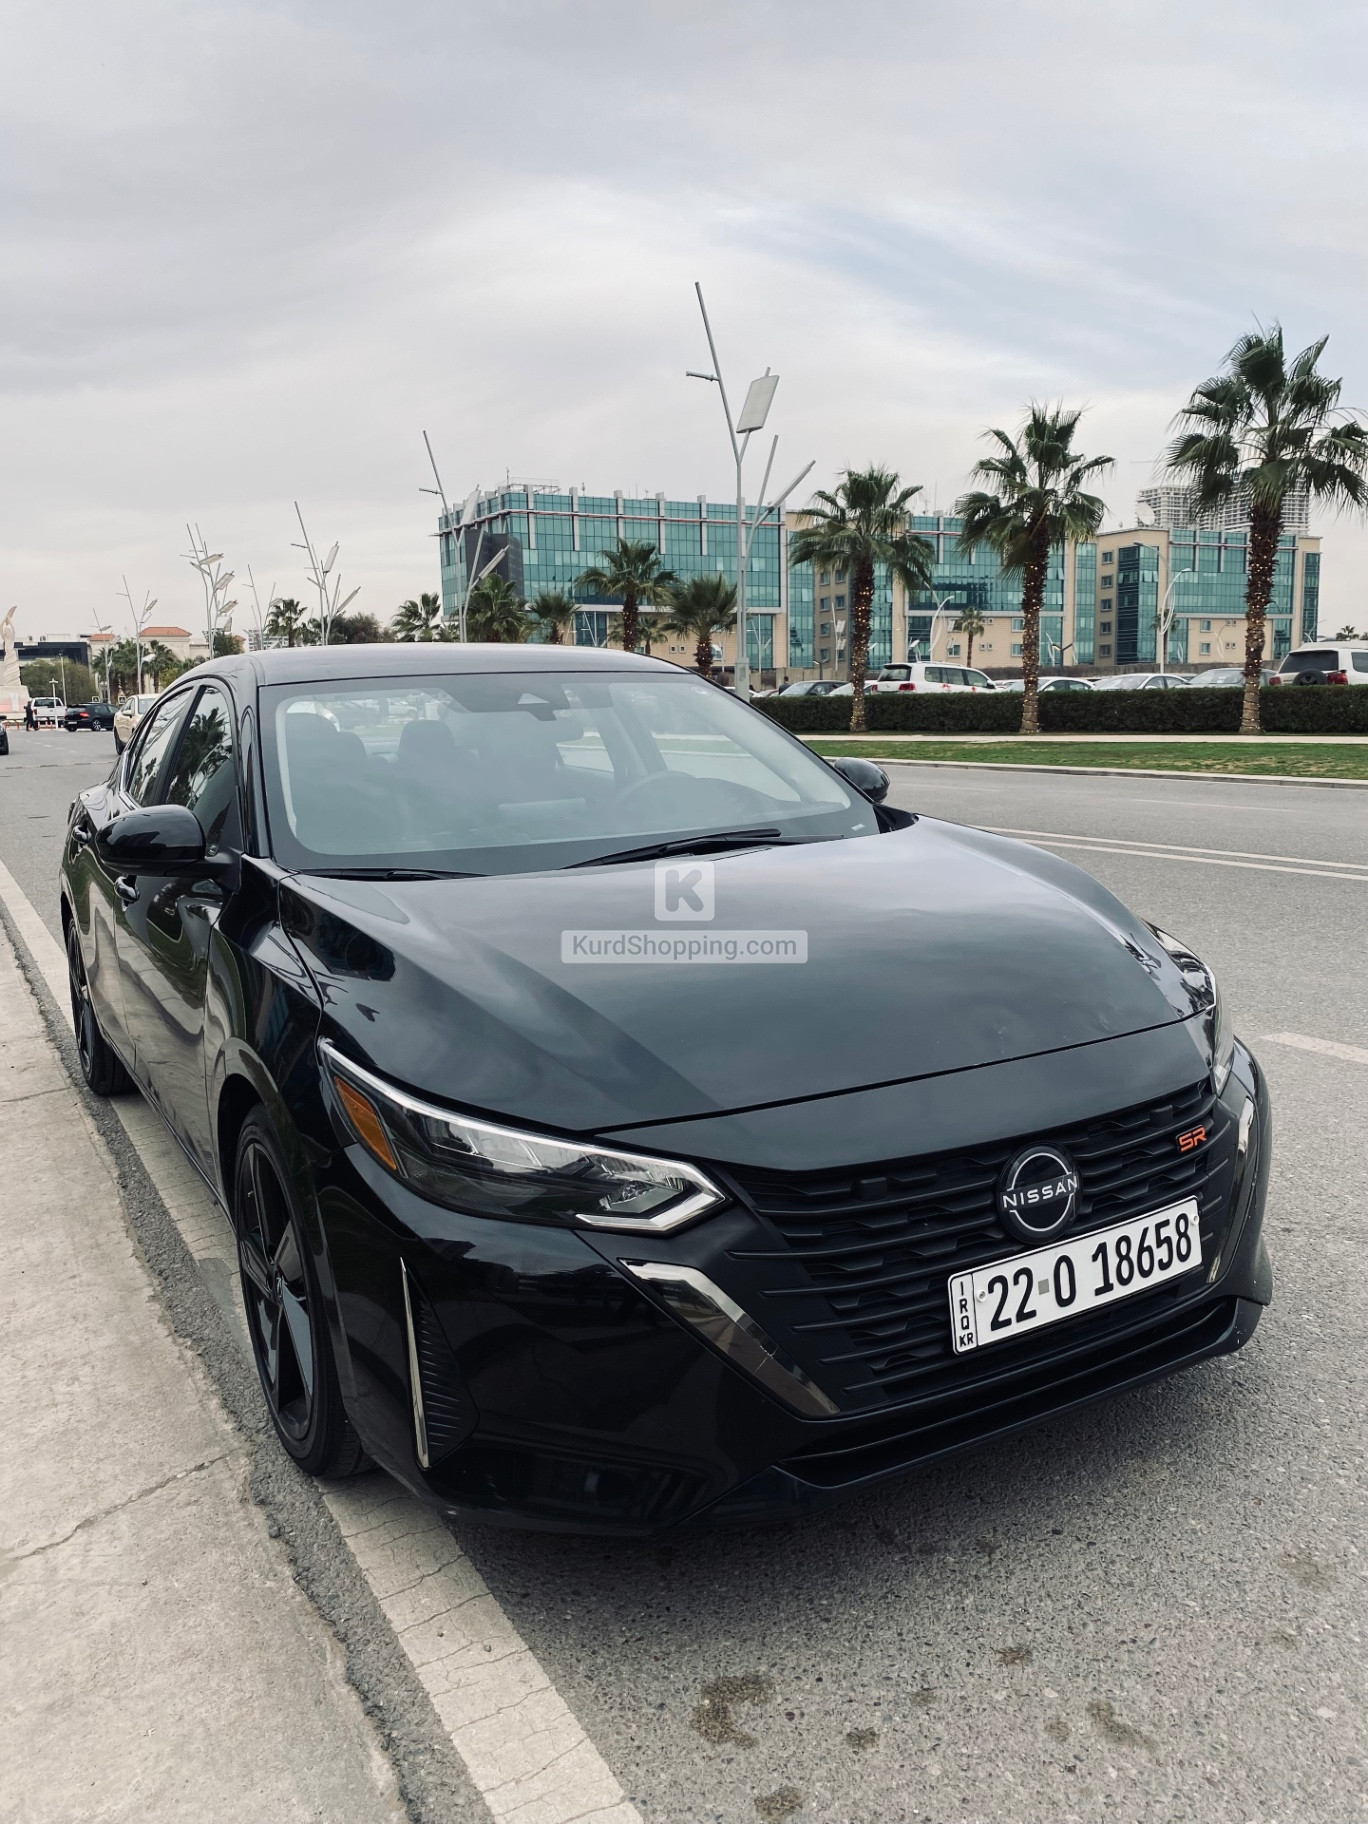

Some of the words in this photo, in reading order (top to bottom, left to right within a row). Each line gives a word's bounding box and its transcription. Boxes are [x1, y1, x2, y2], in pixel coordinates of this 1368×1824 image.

[1179, 1126, 1207, 1152] SR
[1002, 1175, 1078, 1208] NISSAN
[987, 1266, 1037, 1332] 22
[1091, 1212, 1192, 1296] 18658
[959, 1332, 974, 1348] KR
